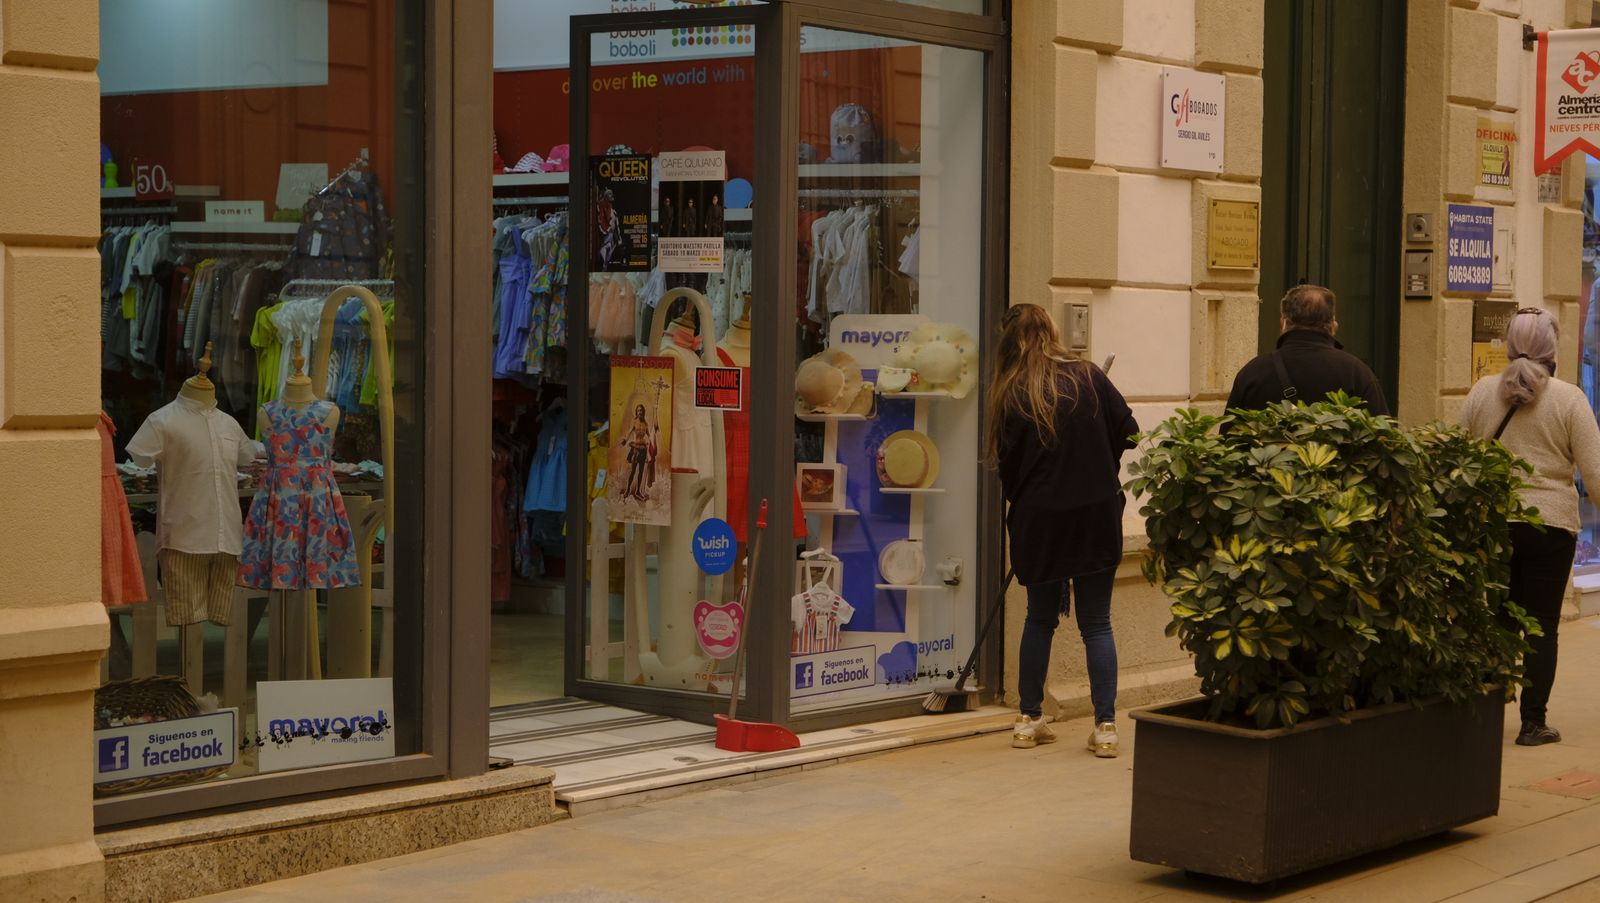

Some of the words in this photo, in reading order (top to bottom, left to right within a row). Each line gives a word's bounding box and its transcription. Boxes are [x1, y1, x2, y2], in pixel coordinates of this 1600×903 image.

[610, 40, 656, 57] boboli
[632, 71, 657, 89] the
[663, 66, 707, 86] world
[713, 65, 745, 83] with
[1476, 129, 1517, 143] OFICINA
[1550, 124, 1580, 133] NIEVES
[1483, 144, 1503, 154] ALQUILA
[599, 160, 648, 178] QUEEN
[1454, 213, 1474, 223] HABITA
[1475, 215, 1493, 225] STATE
[1449, 238, 1459, 255] SE
[1460, 239, 1491, 259] ALQUILA
[1448, 265, 1490, 284] 606943889
[698, 369, 739, 388] CONSUME
[698, 534, 729, 550] wish
[704, 551, 726, 559] PICKUP
[821, 665, 869, 686] facebook
[200, 728, 213, 737] en
[269, 710, 385, 741] mayoral
[359, 735, 385, 743] friends
[142, 740, 223, 766] facebook
